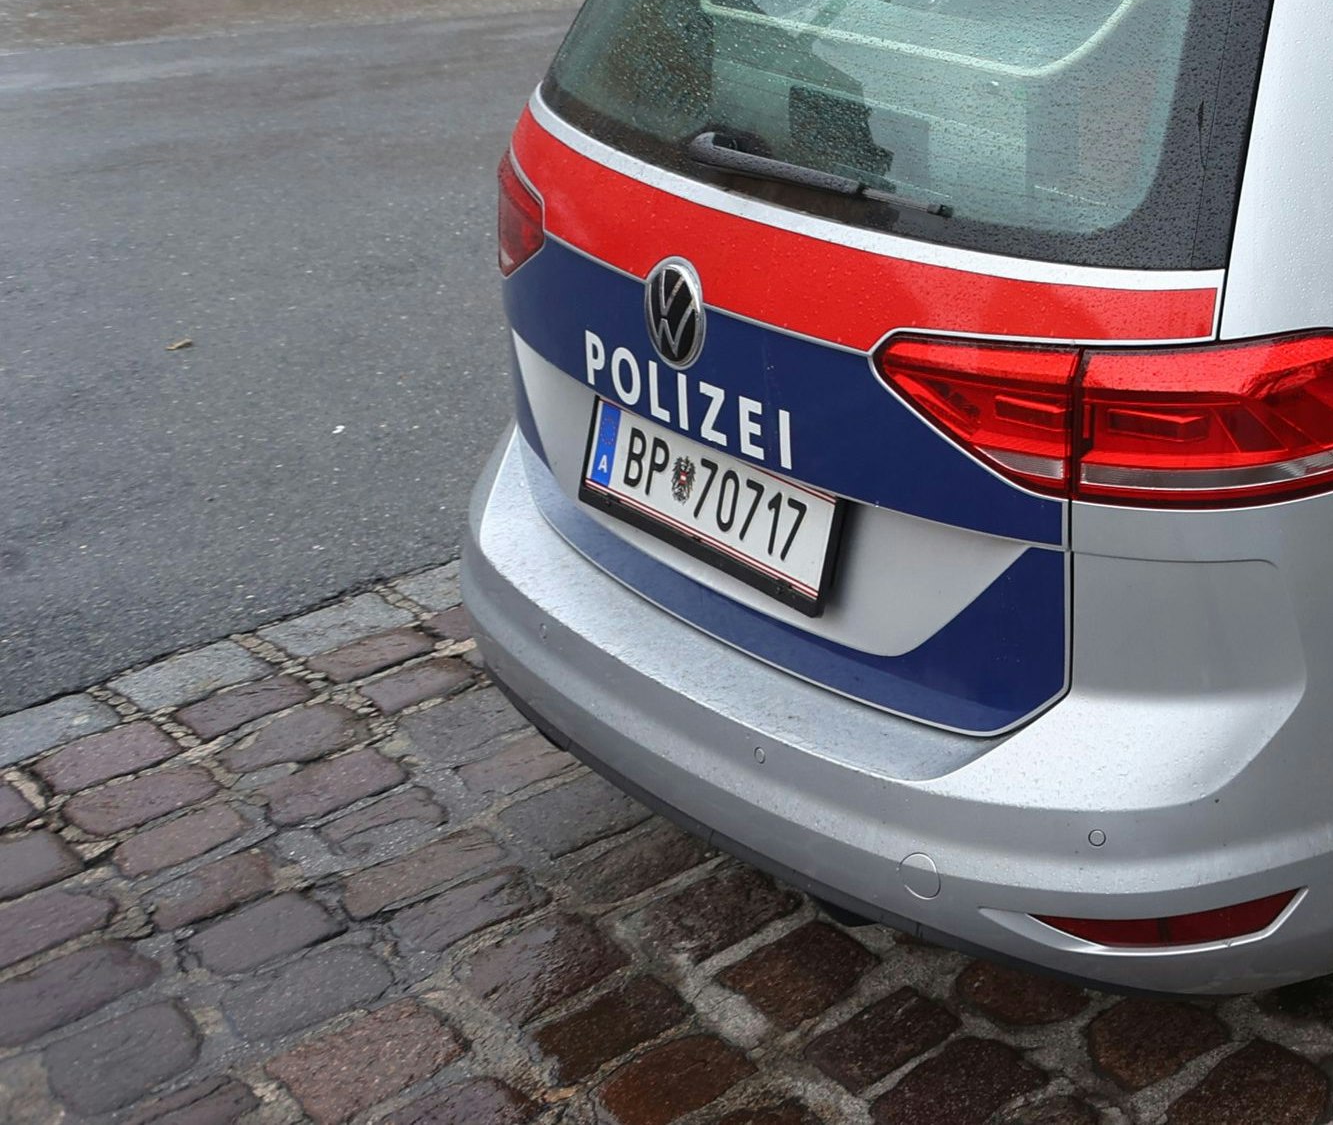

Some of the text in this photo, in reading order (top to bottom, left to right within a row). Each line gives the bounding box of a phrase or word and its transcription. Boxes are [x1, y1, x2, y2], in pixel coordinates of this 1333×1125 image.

[585, 329, 792, 470] POLIZEI
[597, 454, 608, 474] A
[622, 427, 807, 562] BP 70717
